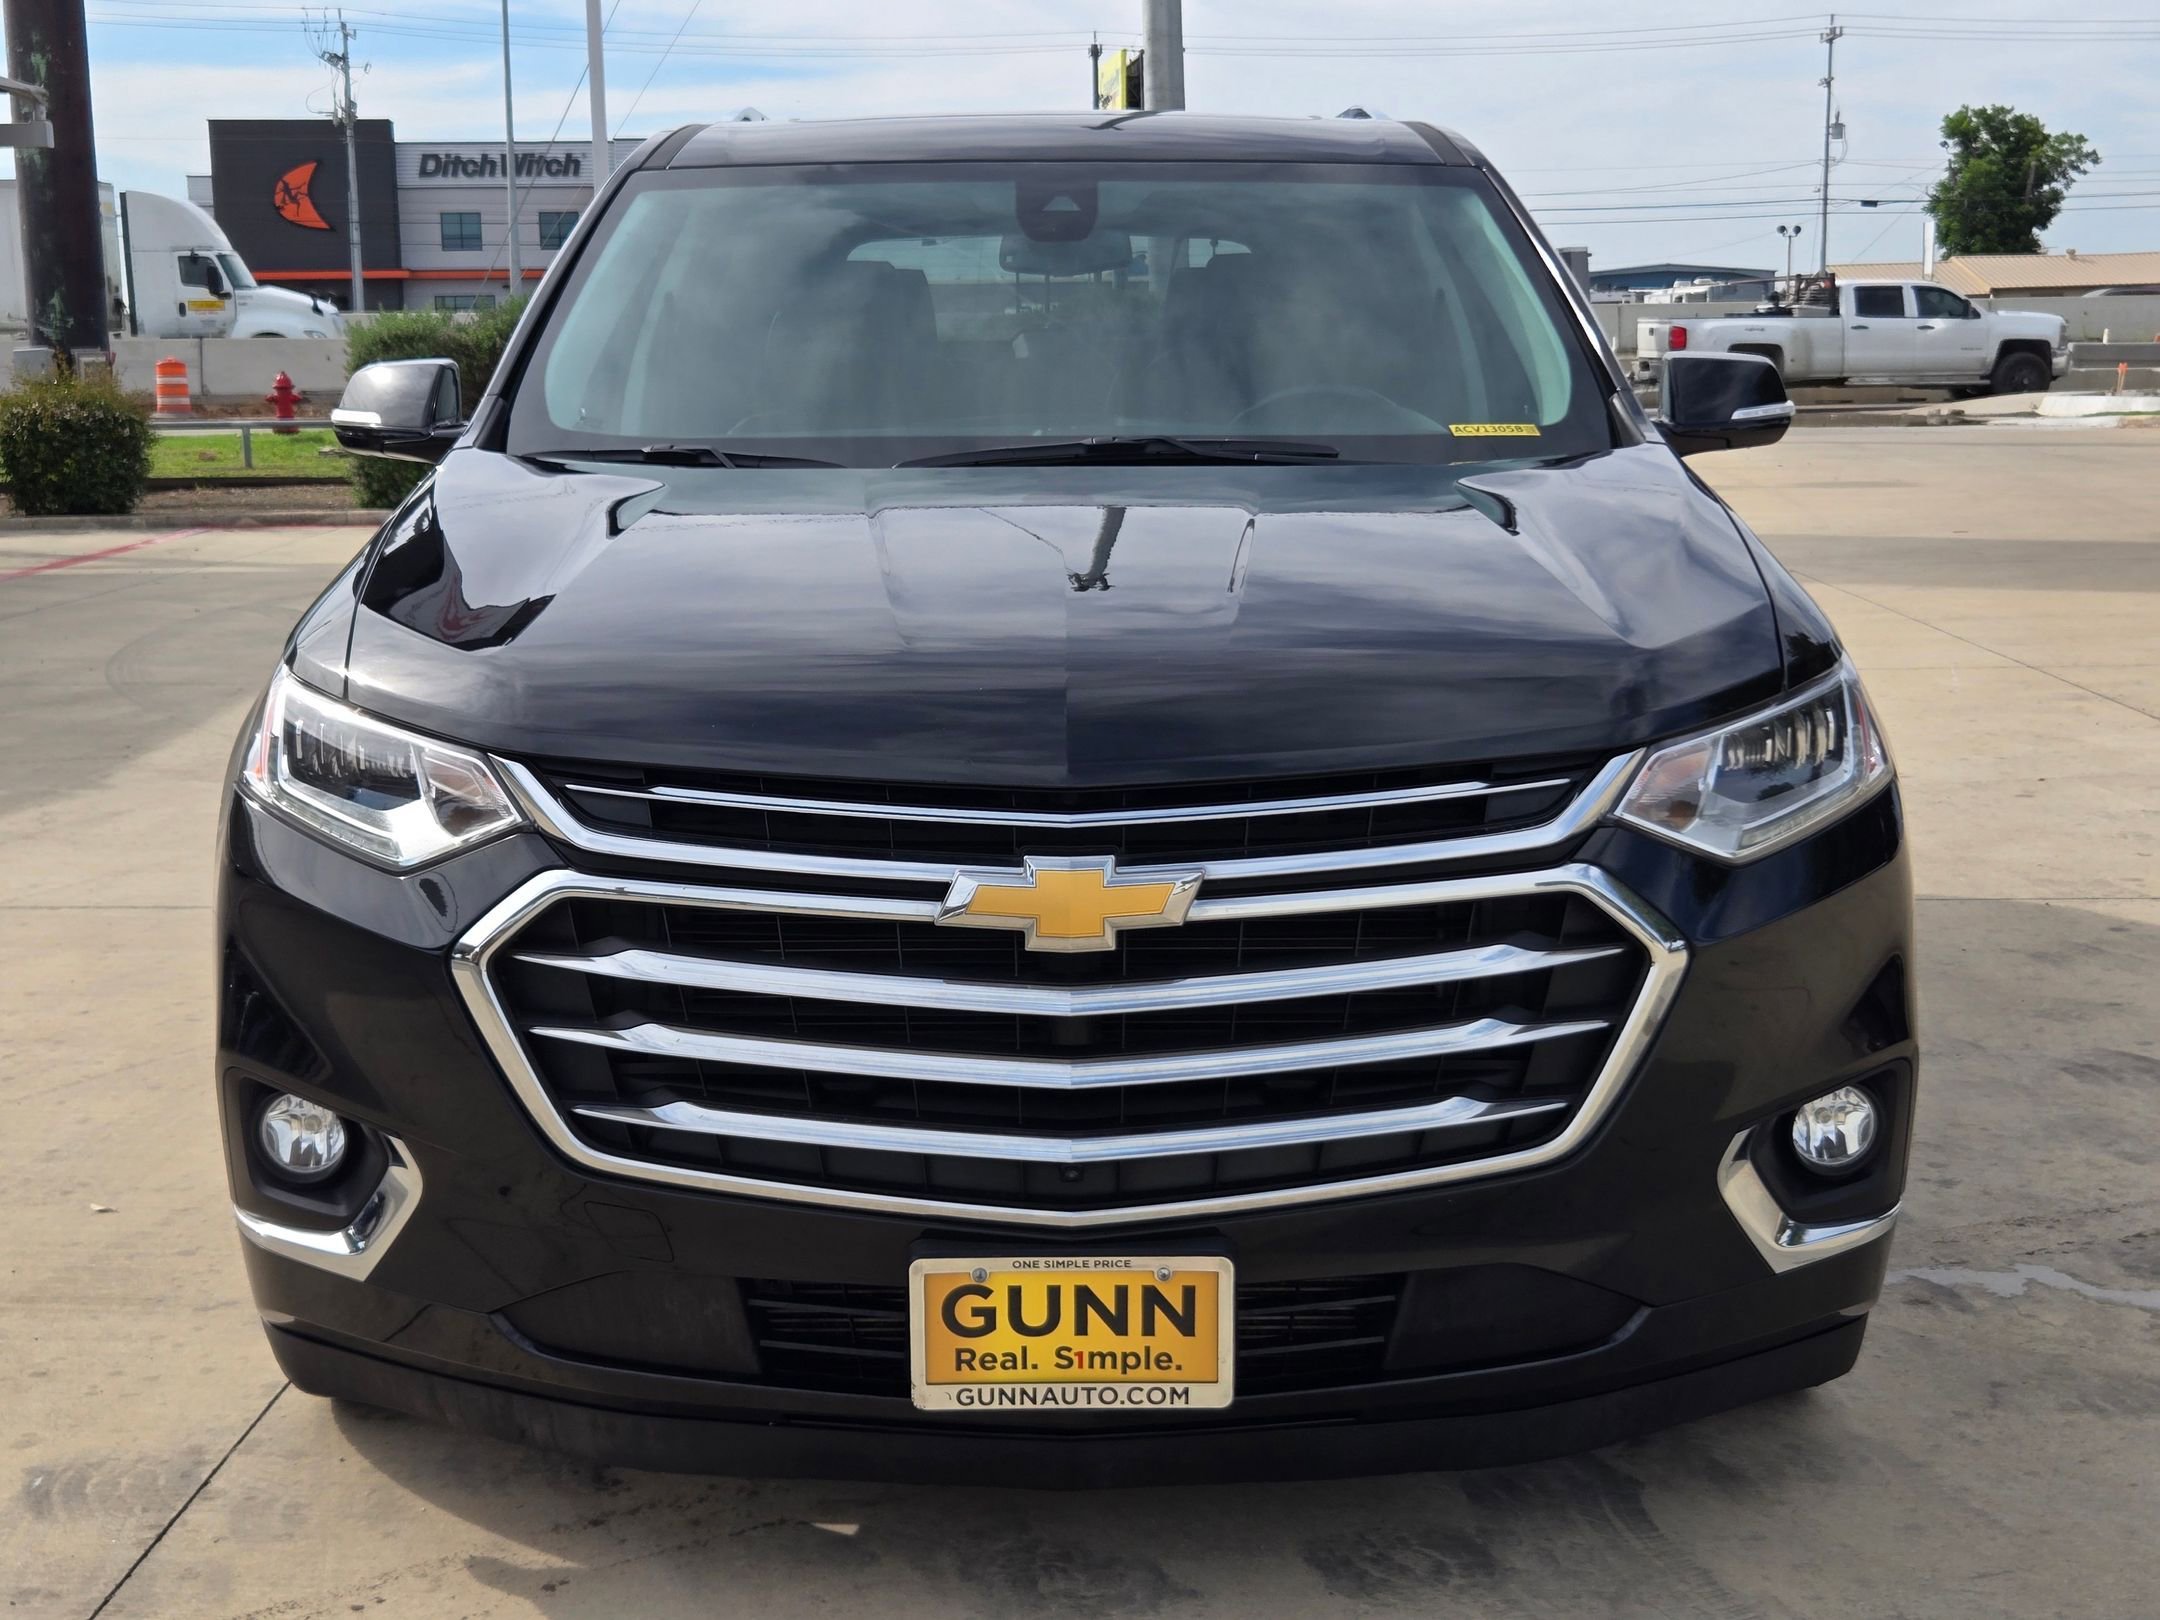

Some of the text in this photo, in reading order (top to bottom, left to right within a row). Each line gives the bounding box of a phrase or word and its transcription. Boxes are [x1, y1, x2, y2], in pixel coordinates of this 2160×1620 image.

[418, 152, 581, 178] Ditch Witch
[1012, 1259, 1132, 1269] ONE SIMPLE PRICE
[941, 1283, 1196, 1338] GUNN
[955, 1346, 1039, 1371] Real.
[956, 1386, 1190, 1406] GUNNAUTO.COM
